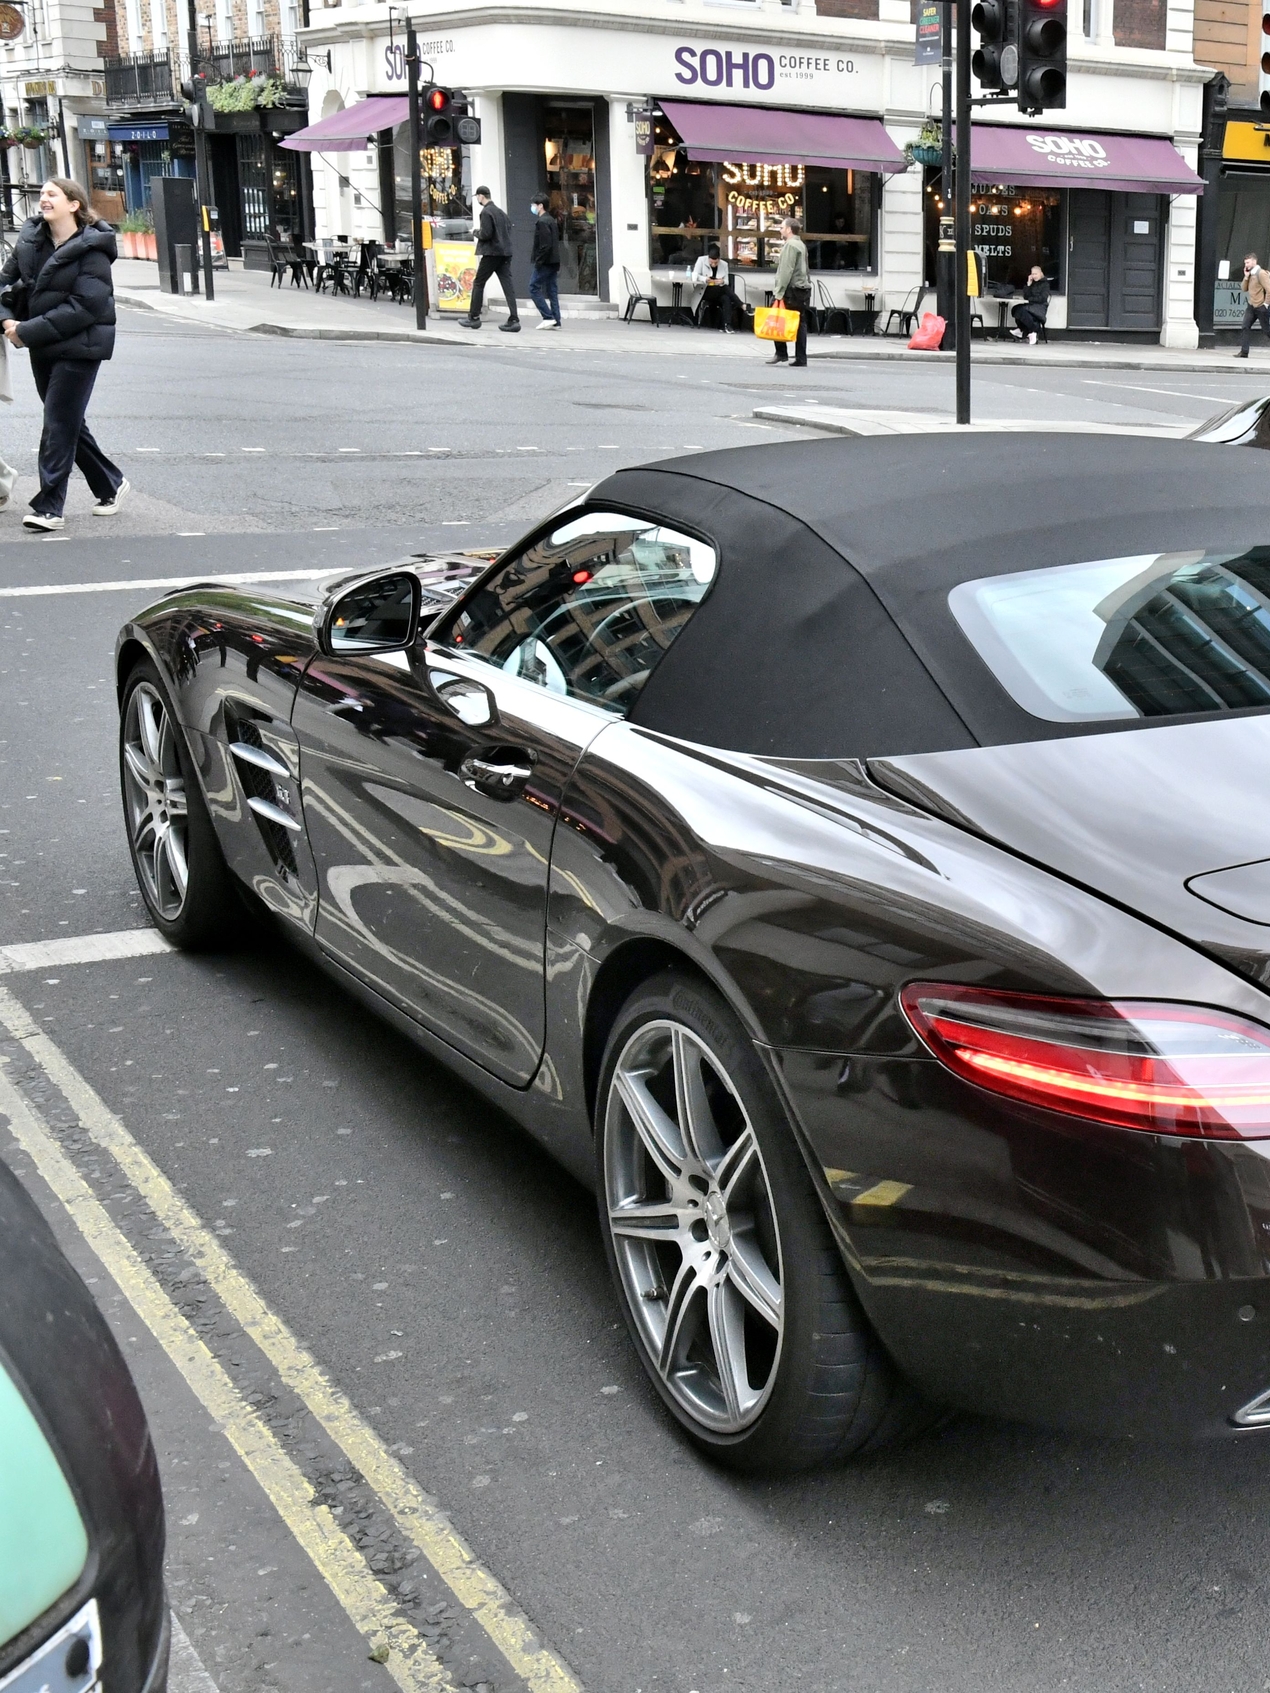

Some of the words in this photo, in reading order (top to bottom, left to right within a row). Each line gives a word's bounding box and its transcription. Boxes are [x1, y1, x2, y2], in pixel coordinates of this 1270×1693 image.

[422, 41, 443, 55] COFFEE
[445, 39, 456, 53] CO.
[674, 46, 775, 91] SOHO
[779, 55, 830, 72] COFFEE
[836, 59, 859, 74] CO.
[779, 71, 793, 79] est
[795, 72, 814, 80] 1999
[636, 120, 651, 135] SOHO
[1025, 134, 1107, 159] SOHO
[1047, 154, 1095, 168] COFFEE
[722, 161, 806, 187] SOHO
[971, 183, 1016, 196] JUICES
[728, 190, 774, 213] COFFEE
[778, 193, 799, 209] CO.
[974, 225, 1012, 237] SPUDS
[974, 245, 1012, 257] MELTS
[1214, 309, 1227, 318] 020
[1228, 309, 1244, 318] 7629
